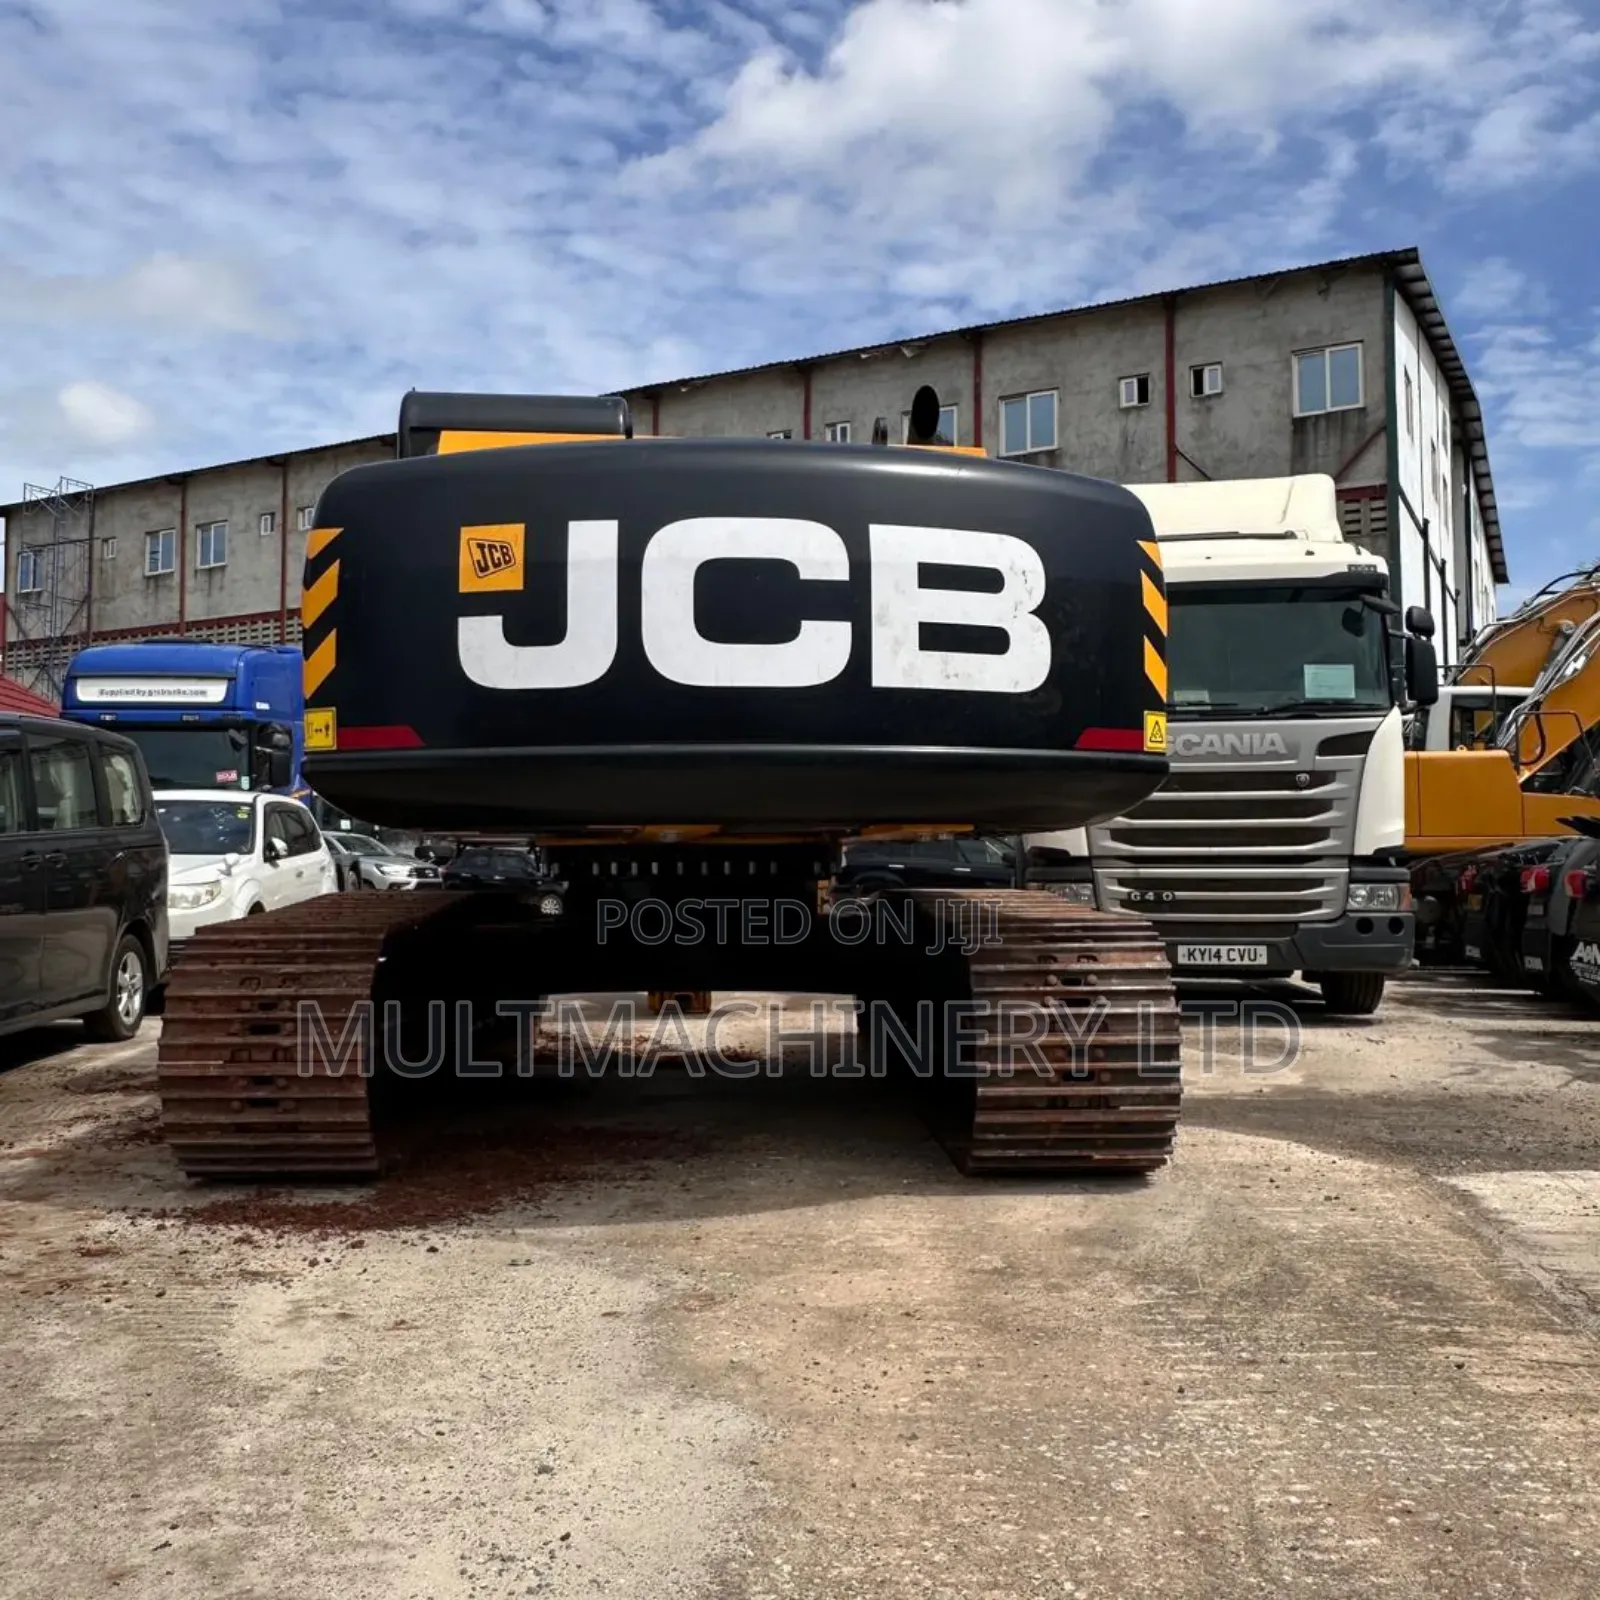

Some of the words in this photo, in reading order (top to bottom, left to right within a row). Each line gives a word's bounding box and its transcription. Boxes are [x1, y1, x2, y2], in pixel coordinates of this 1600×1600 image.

[475, 541, 512, 573] JCB
[457, 516, 1052, 693] JCB
[1187, 948, 1222, 961] KY14
[1226, 948, 1257, 961] CVU
